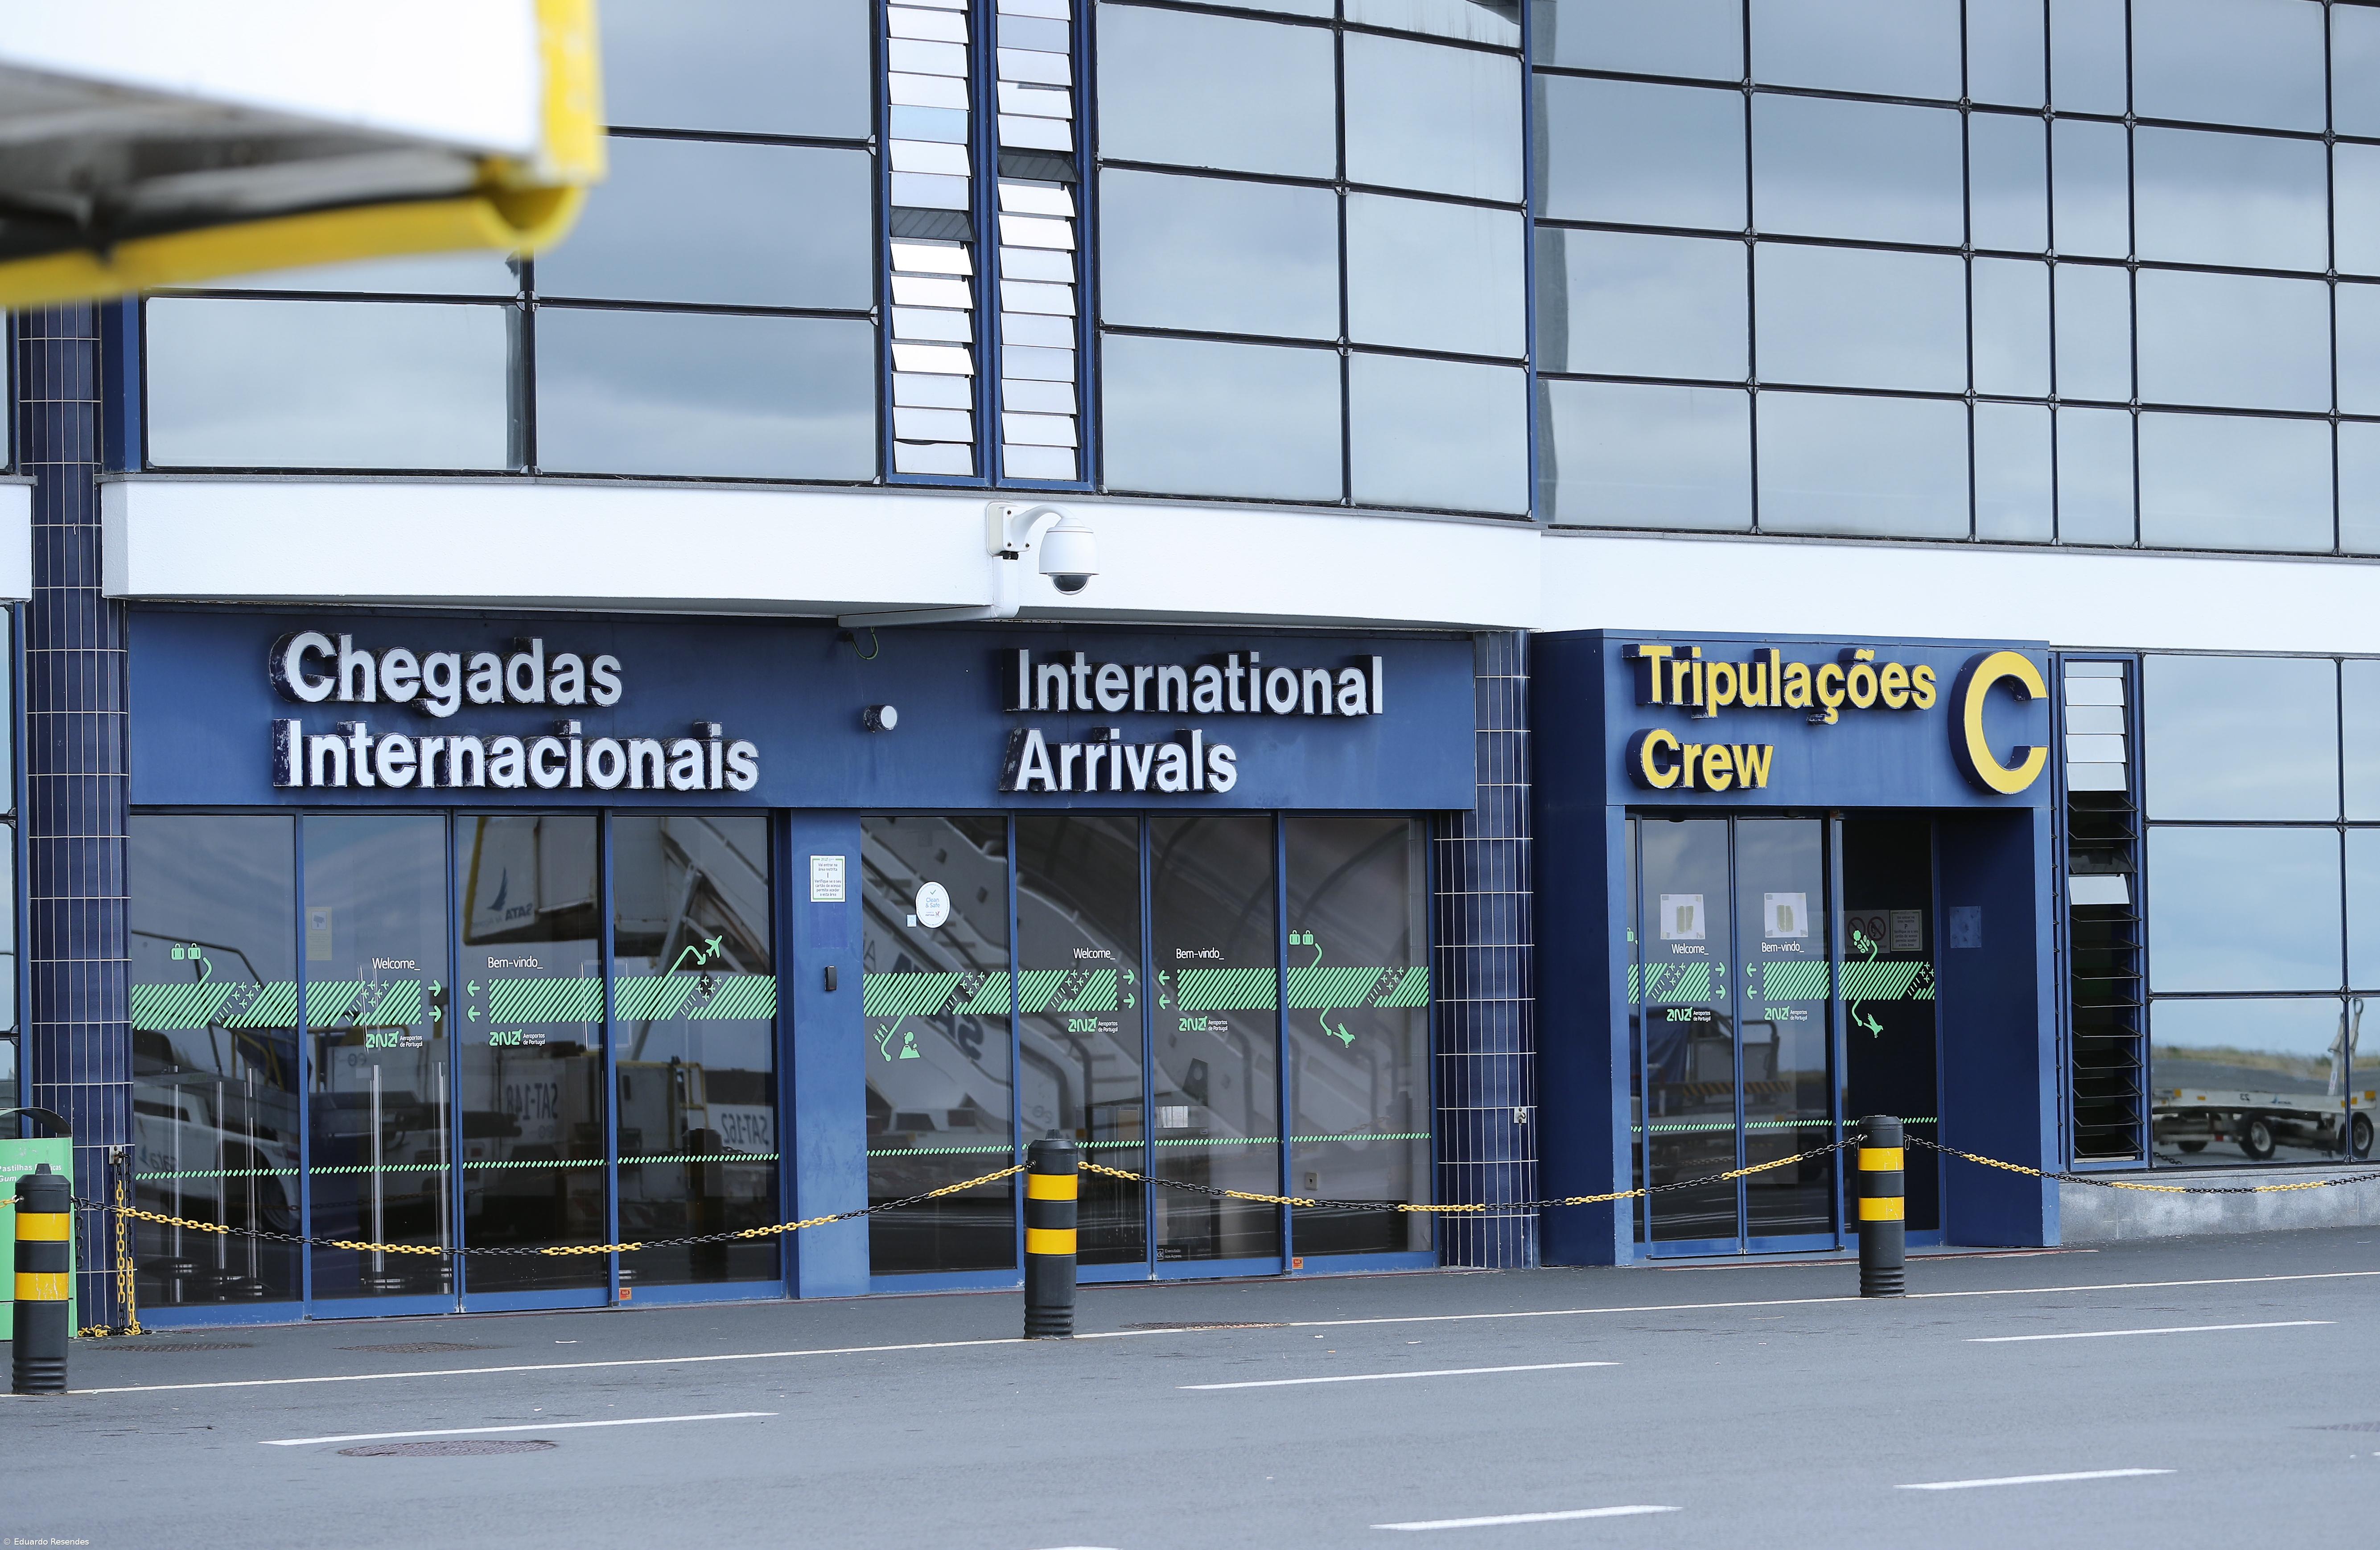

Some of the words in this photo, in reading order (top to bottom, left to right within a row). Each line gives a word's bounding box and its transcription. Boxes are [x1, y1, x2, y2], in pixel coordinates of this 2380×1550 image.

[270, 630, 622, 718] Chegadas
[1002, 648, 1384, 716] International
[1622, 643, 1937, 725] Tripulações
[272, 718, 760, 791] Internacionais
[1948, 650, 2049, 796] C
[999, 727, 1239, 794] Arrivals
[1625, 728, 1775, 793] Crew
